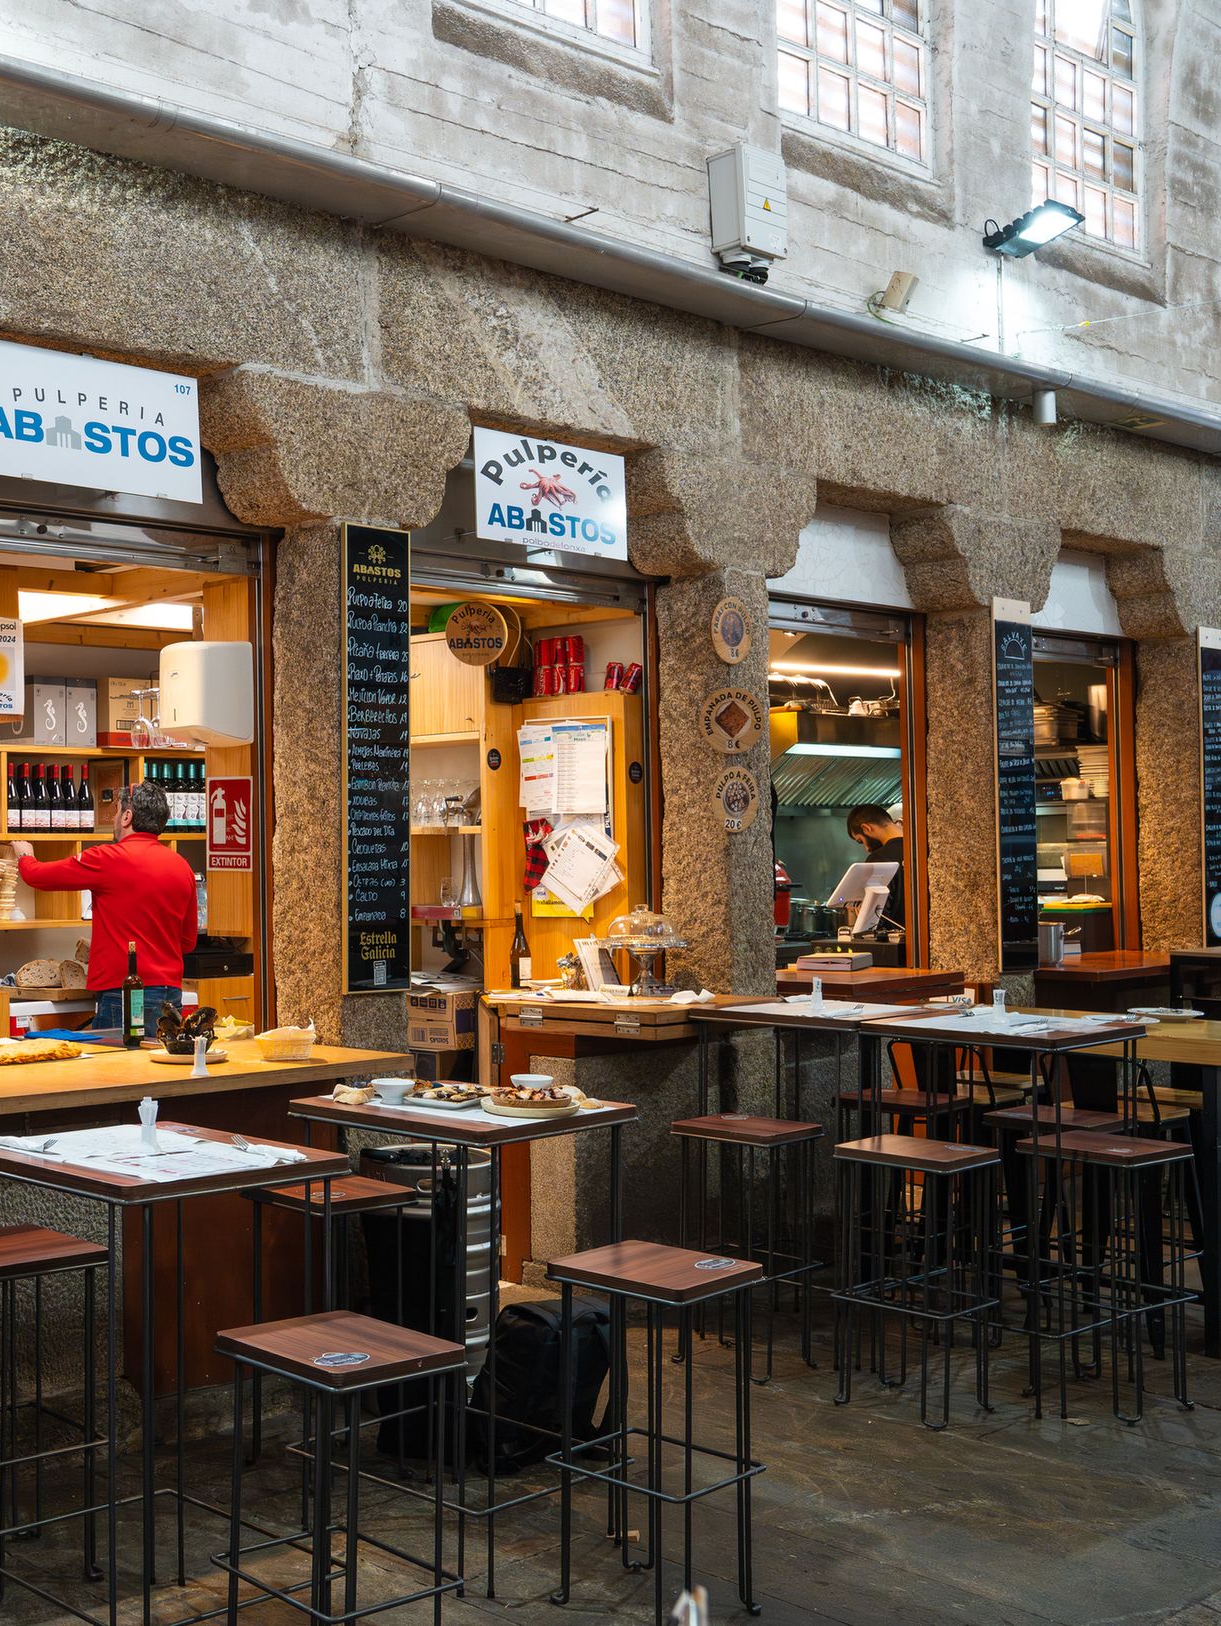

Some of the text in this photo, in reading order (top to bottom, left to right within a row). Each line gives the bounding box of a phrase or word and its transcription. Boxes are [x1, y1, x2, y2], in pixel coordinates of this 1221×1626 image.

[173, 383, 191, 396] 107
[12, 387, 165, 426] PULPERIA
[480, 439, 611, 502] Pulpería
[522, 537, 586, 552] polbodelonxa
[397, 600, 408, 612] 20
[399, 621, 408, 634] 22
[401, 650, 408, 662] 25
[400, 671, 408, 682] 16
[398, 694, 408, 704] 12
[704, 692, 762, 736] EMPANADA DE PULPO
[716, 771, 734, 799] PULPO
[742, 774, 756, 800] FEIRA
[400, 841, 408, 852] 10
[211, 857, 248, 867] EXTINTOR
[399, 878, 406, 887] 3
[400, 891, 406, 901] 9
[399, 908, 406, 919] 8
[359, 931, 397, 946] Estrella
[361, 946, 396, 961] Galicia
[951, 996, 972, 1004] VISA
